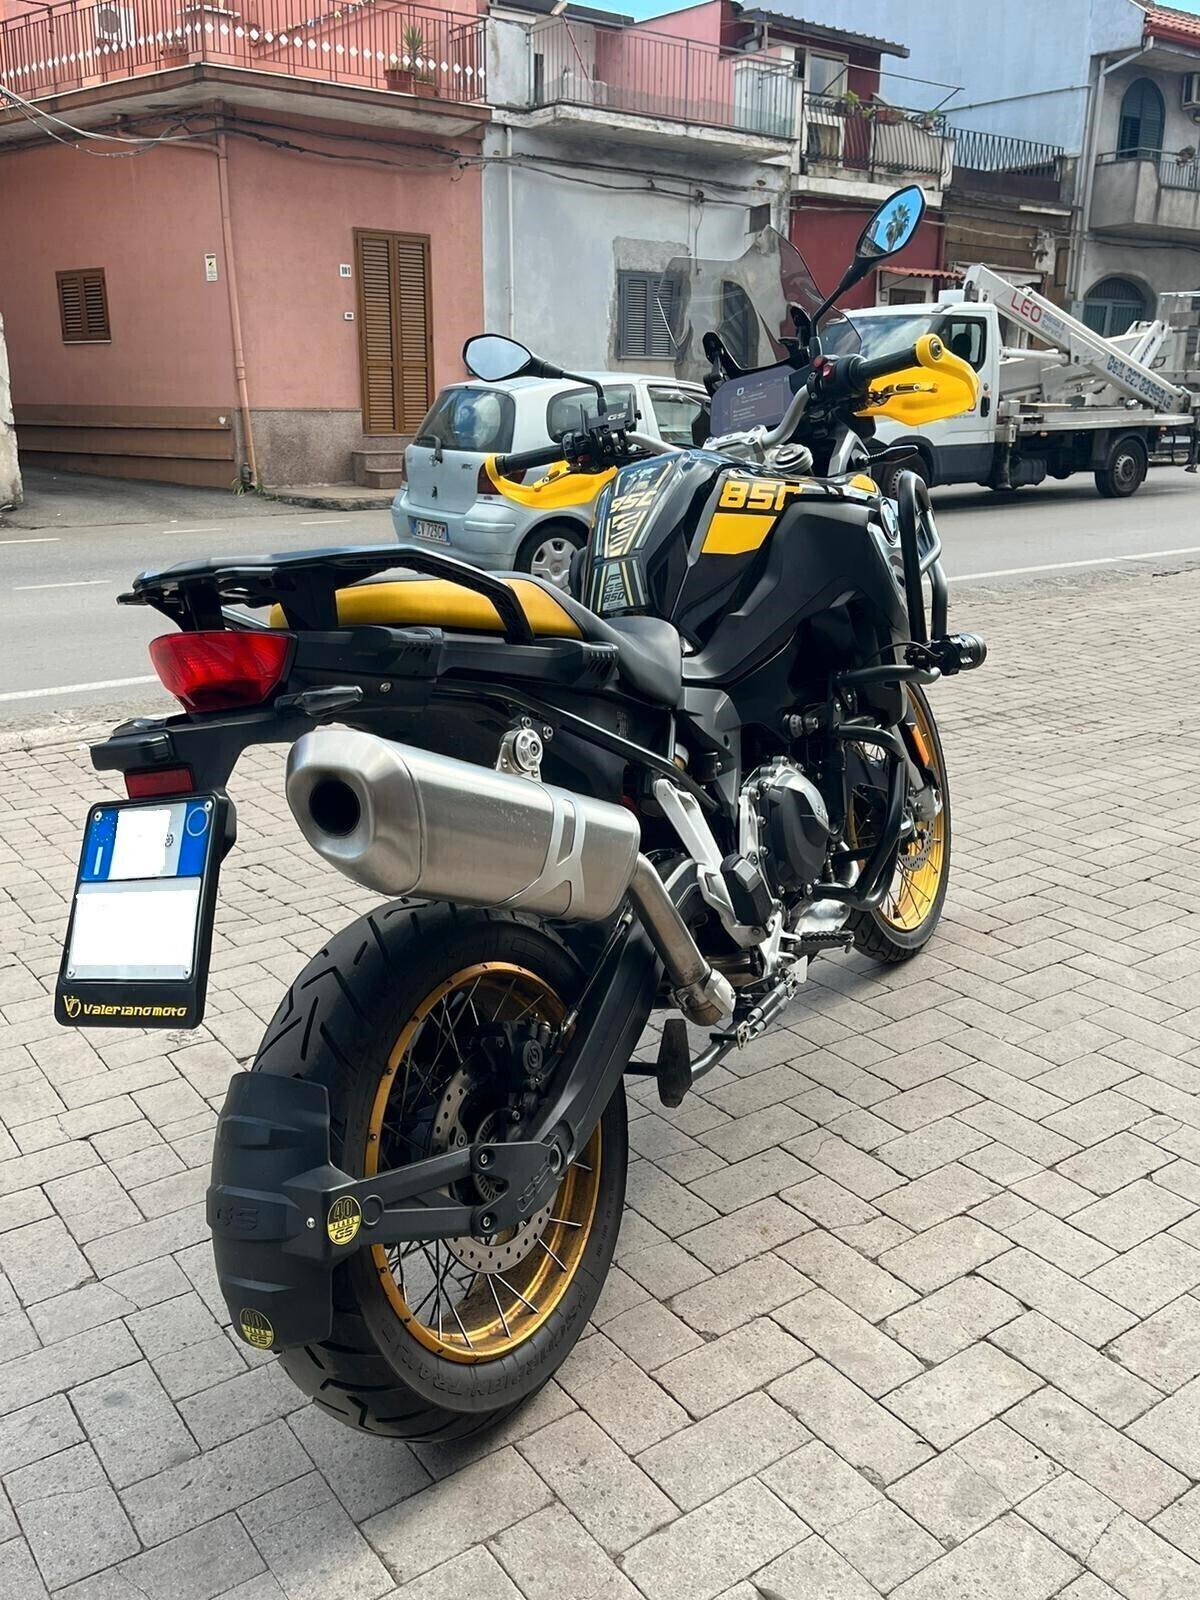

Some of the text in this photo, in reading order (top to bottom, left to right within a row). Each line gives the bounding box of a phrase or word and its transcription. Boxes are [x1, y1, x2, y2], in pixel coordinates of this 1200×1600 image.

[1010, 292, 1042, 323] LEO
[607, 411, 627, 421] GS
[604, 591, 626, 604] 850
[333, 1199, 353, 1221] 40
[335, 1225, 354, 1240] GS
[245, 1310, 263, 1329] 40
[250, 1334, 267, 1344] GS
